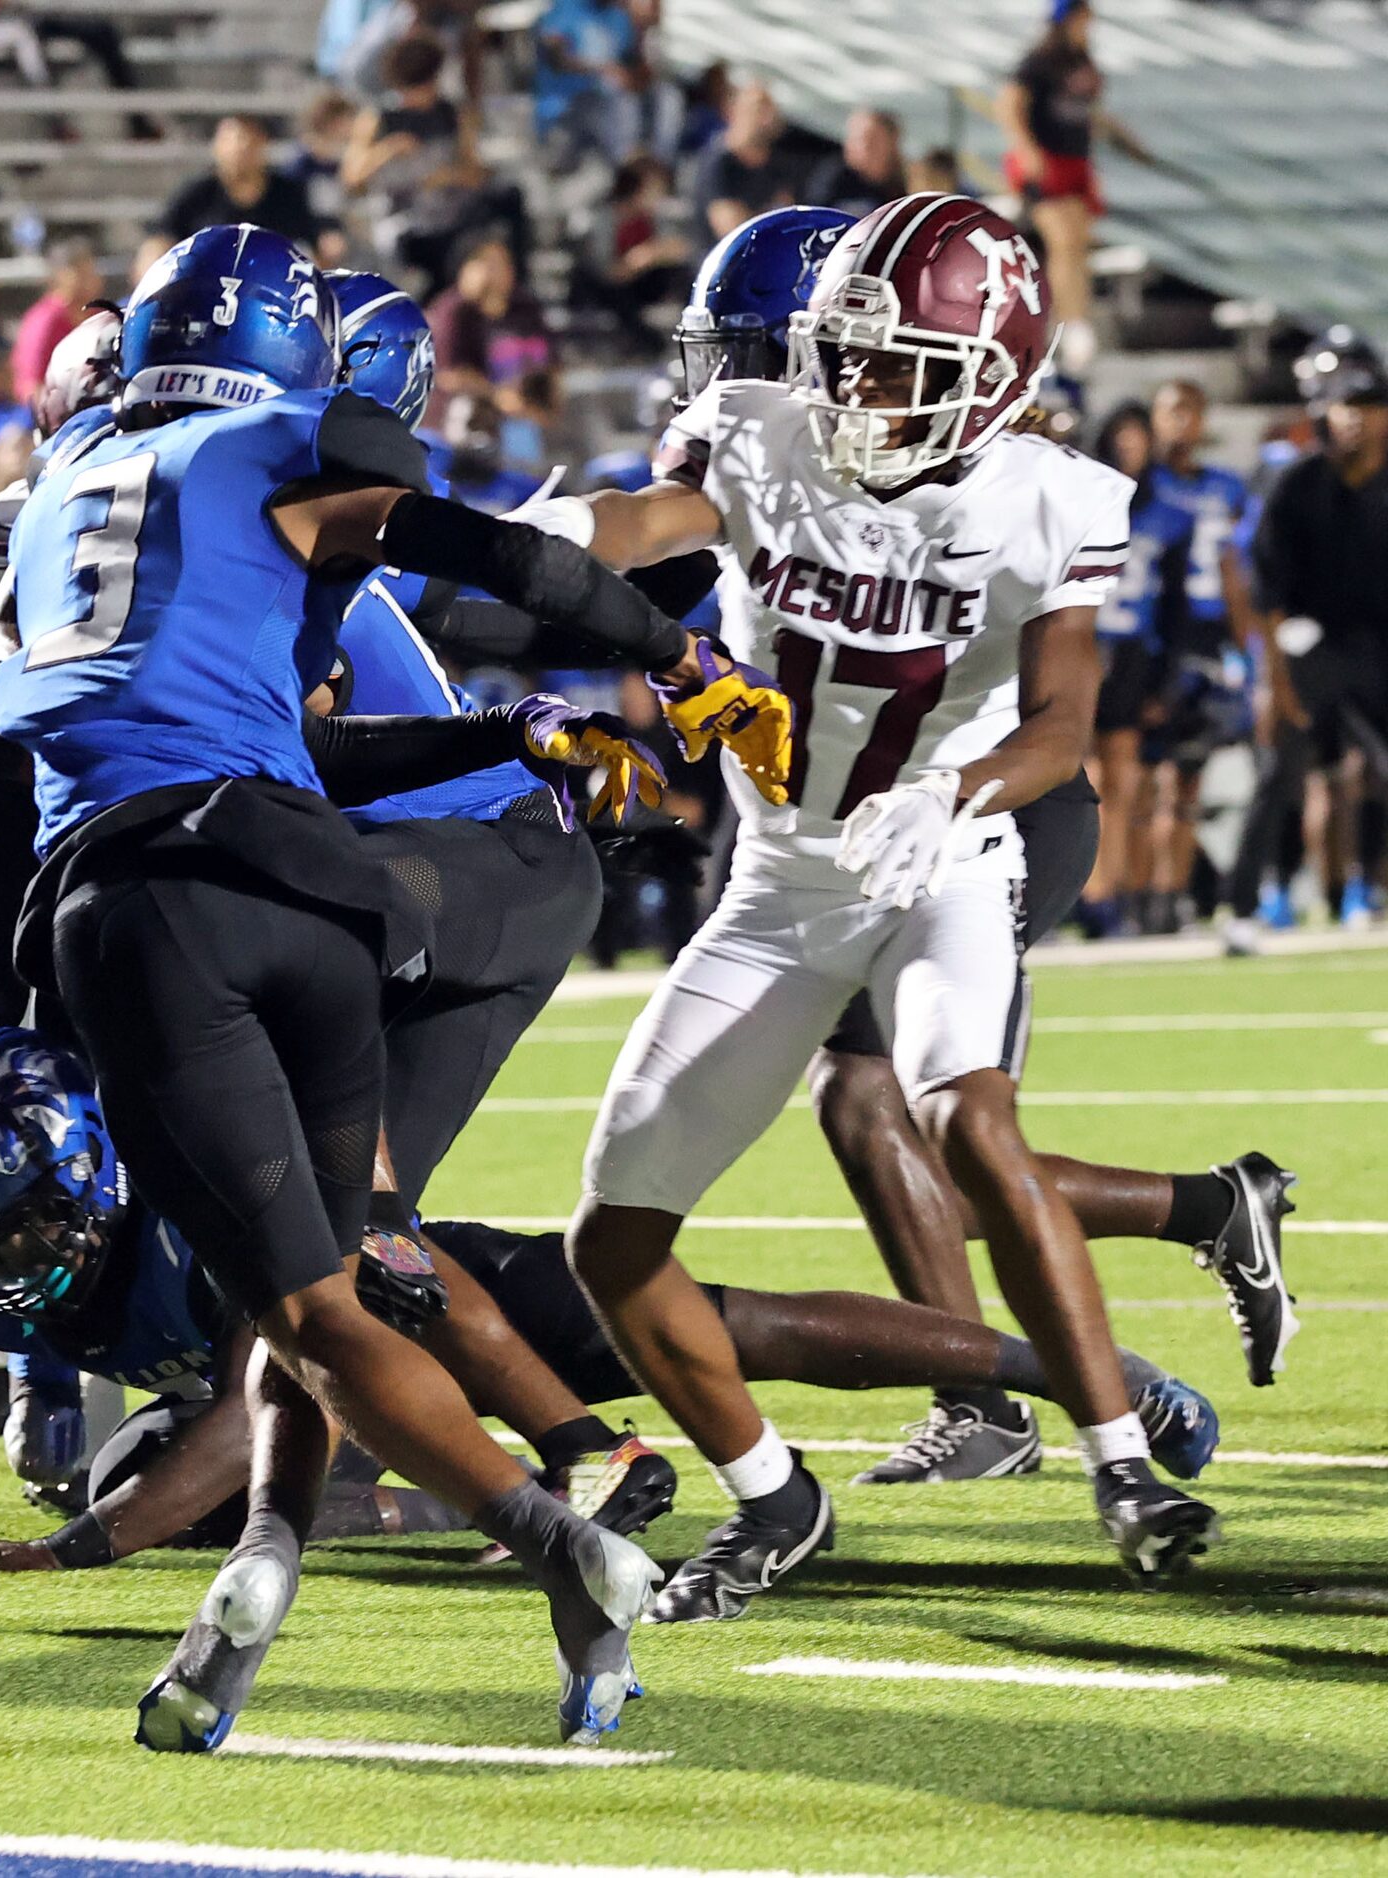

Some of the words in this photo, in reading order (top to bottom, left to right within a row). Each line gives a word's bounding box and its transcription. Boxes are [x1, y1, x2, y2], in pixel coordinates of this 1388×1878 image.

[212, 276, 244, 327] 3
[155, 371, 208, 395] LET'S
[213, 375, 266, 405] RIDE
[22, 451, 157, 674] 3
[748, 546, 980, 636] MESQUITE
[772, 628, 948, 821] 17
